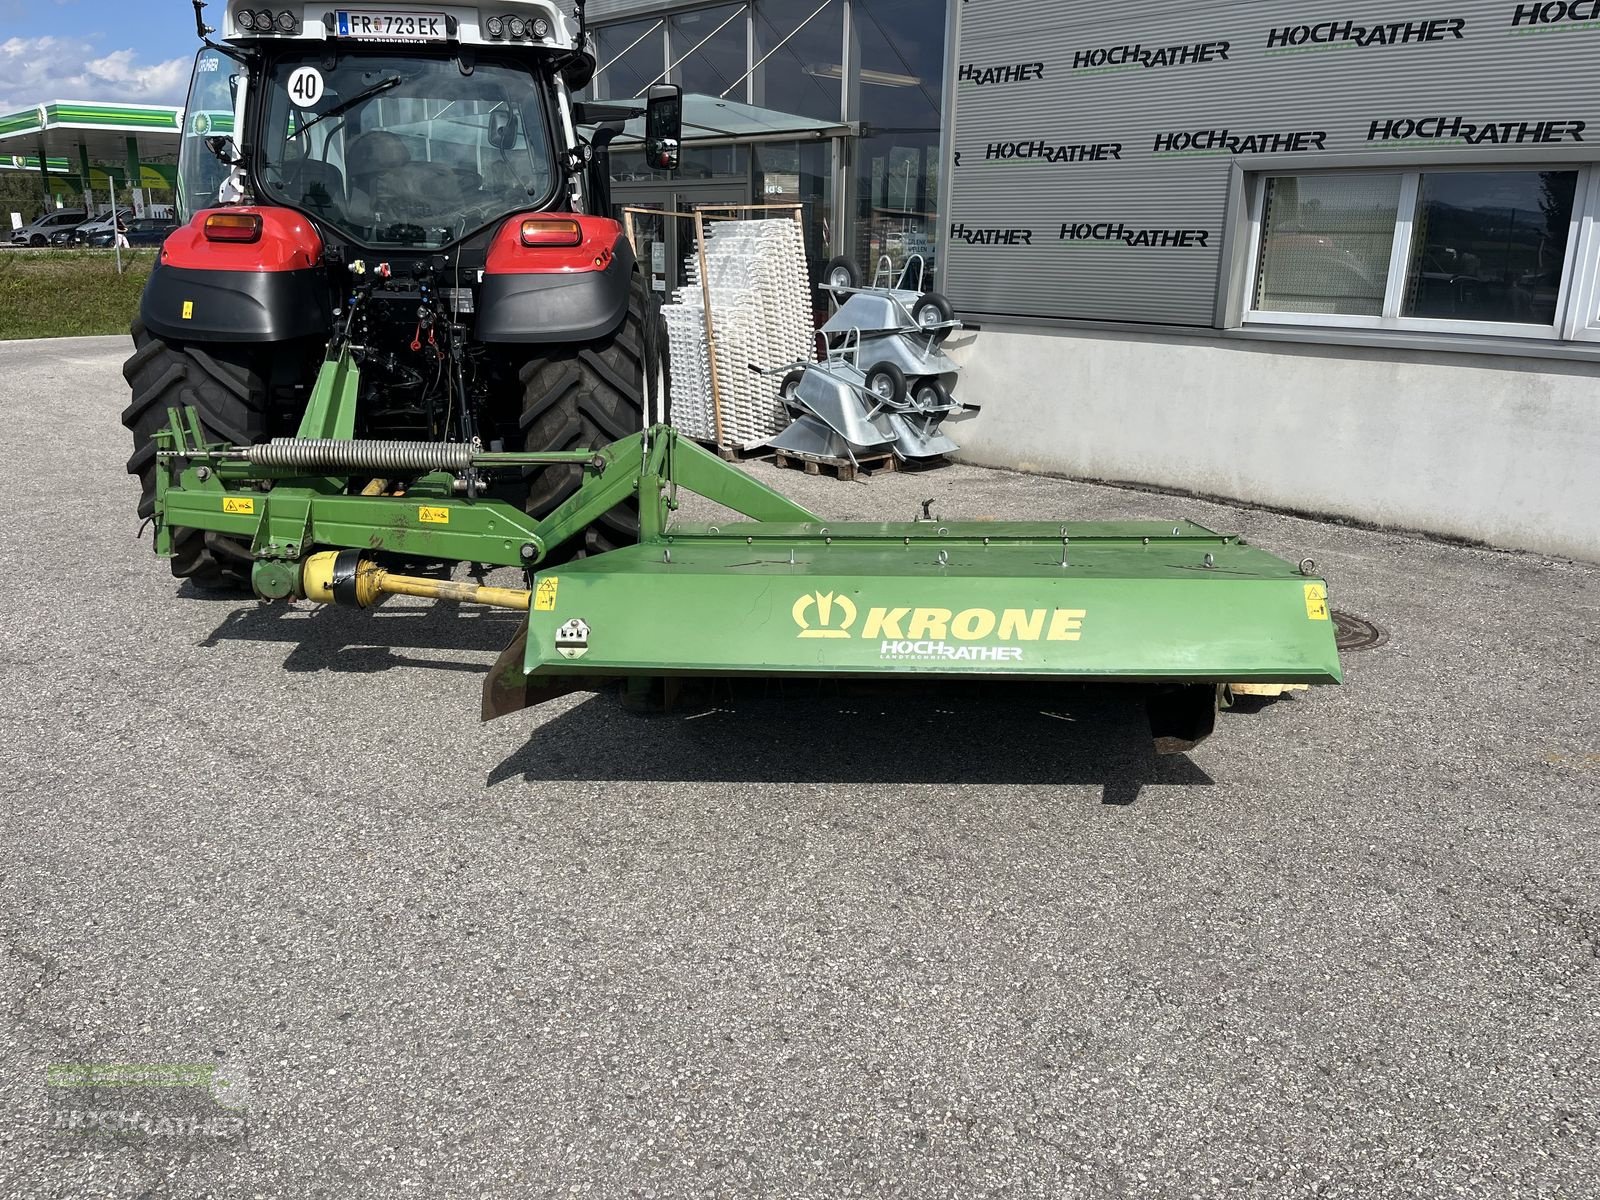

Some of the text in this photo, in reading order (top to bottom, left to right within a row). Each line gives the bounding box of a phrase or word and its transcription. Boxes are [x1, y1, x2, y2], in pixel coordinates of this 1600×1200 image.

[351, 16, 372, 33] FR
[384, 17, 415, 34] 723
[419, 18, 439, 35] EK
[1266, 18, 1465, 48] HOCHRATHER
[1072, 41, 1230, 69] HOCHRATHER
[293, 73, 316, 99] 40
[1153, 129, 1327, 154] HOCHRATHER
[1367, 116, 1586, 144] HOCHRATHER
[985, 140, 1122, 163] HOCHRATHER
[1059, 223, 1209, 247] HOCHRATHER
[861, 607, 1087, 641] KRONE
[880, 641, 1023, 661] HOCHRATHER
